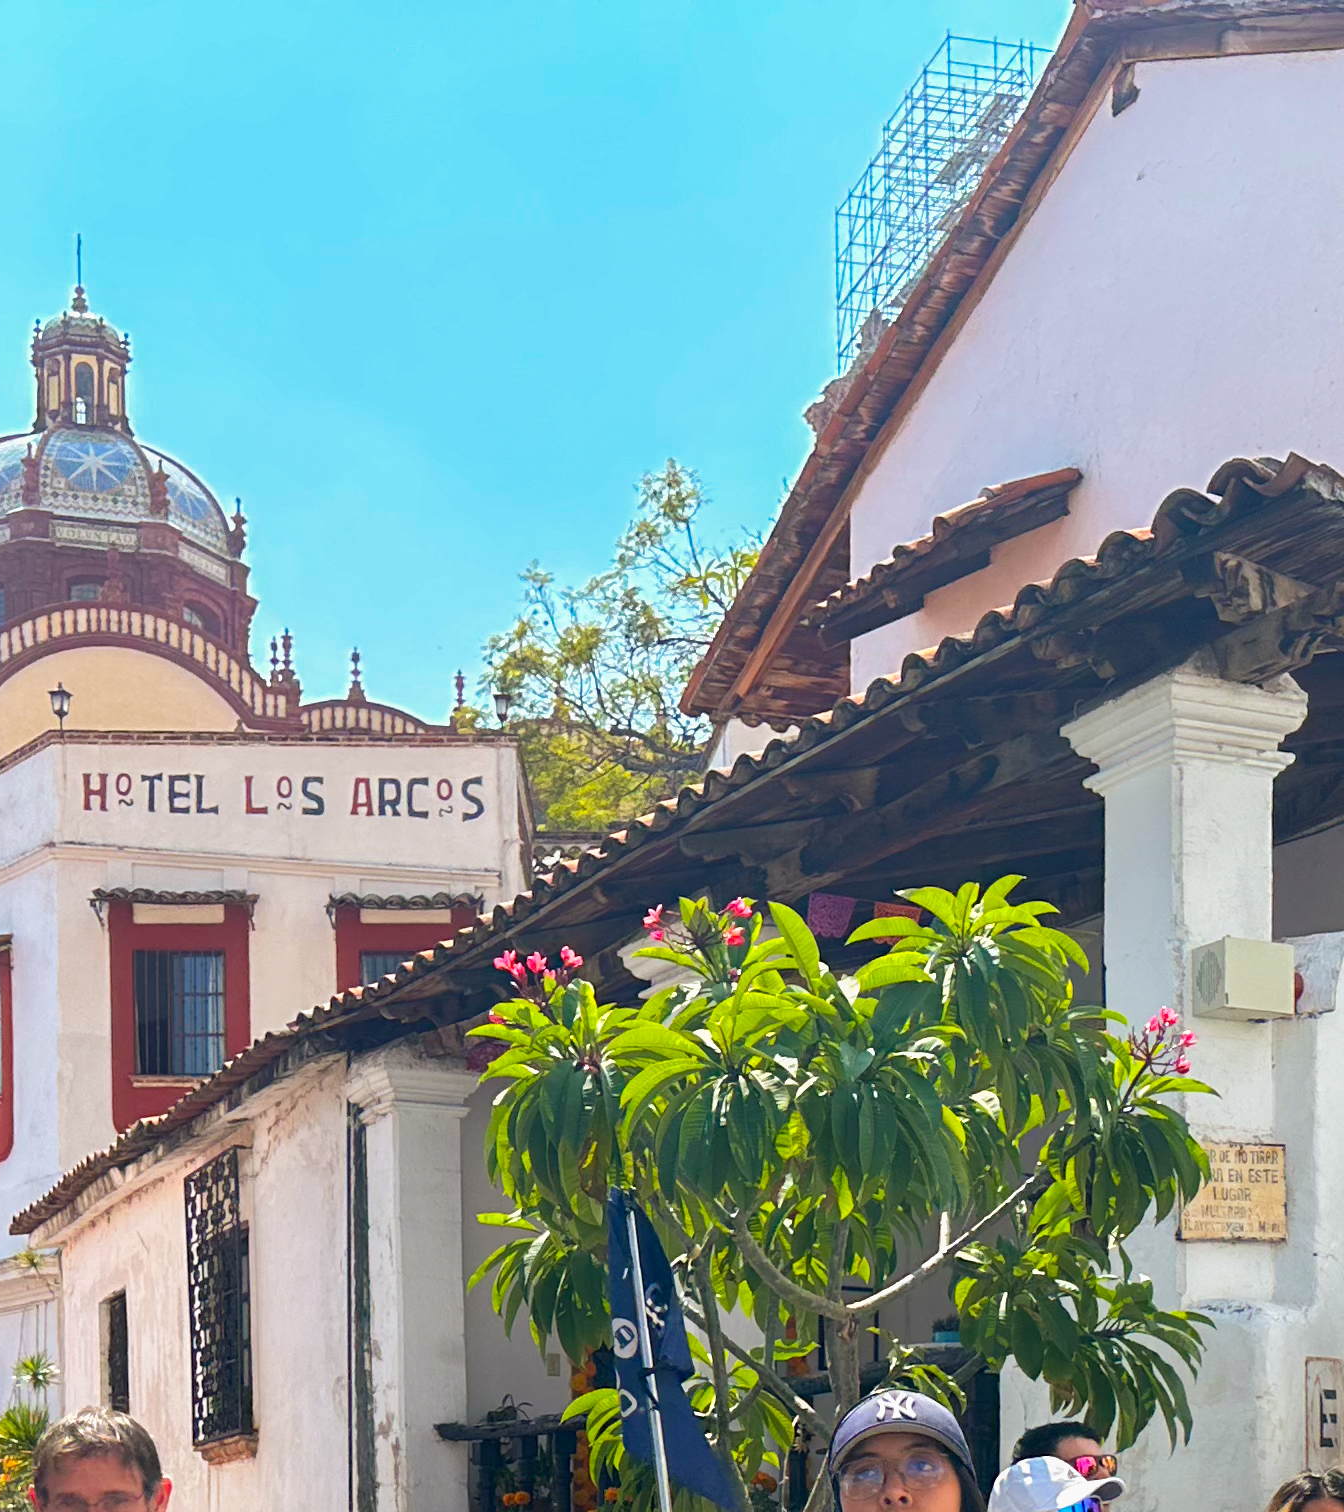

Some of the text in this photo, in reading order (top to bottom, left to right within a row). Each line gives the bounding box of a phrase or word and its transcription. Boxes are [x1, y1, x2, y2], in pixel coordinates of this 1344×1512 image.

[81, 771, 486, 823] HOTEL LOS ARCOS
[1228, 1168, 1243, 1183] EN
[1248, 1168, 1279, 1184] ESTE
